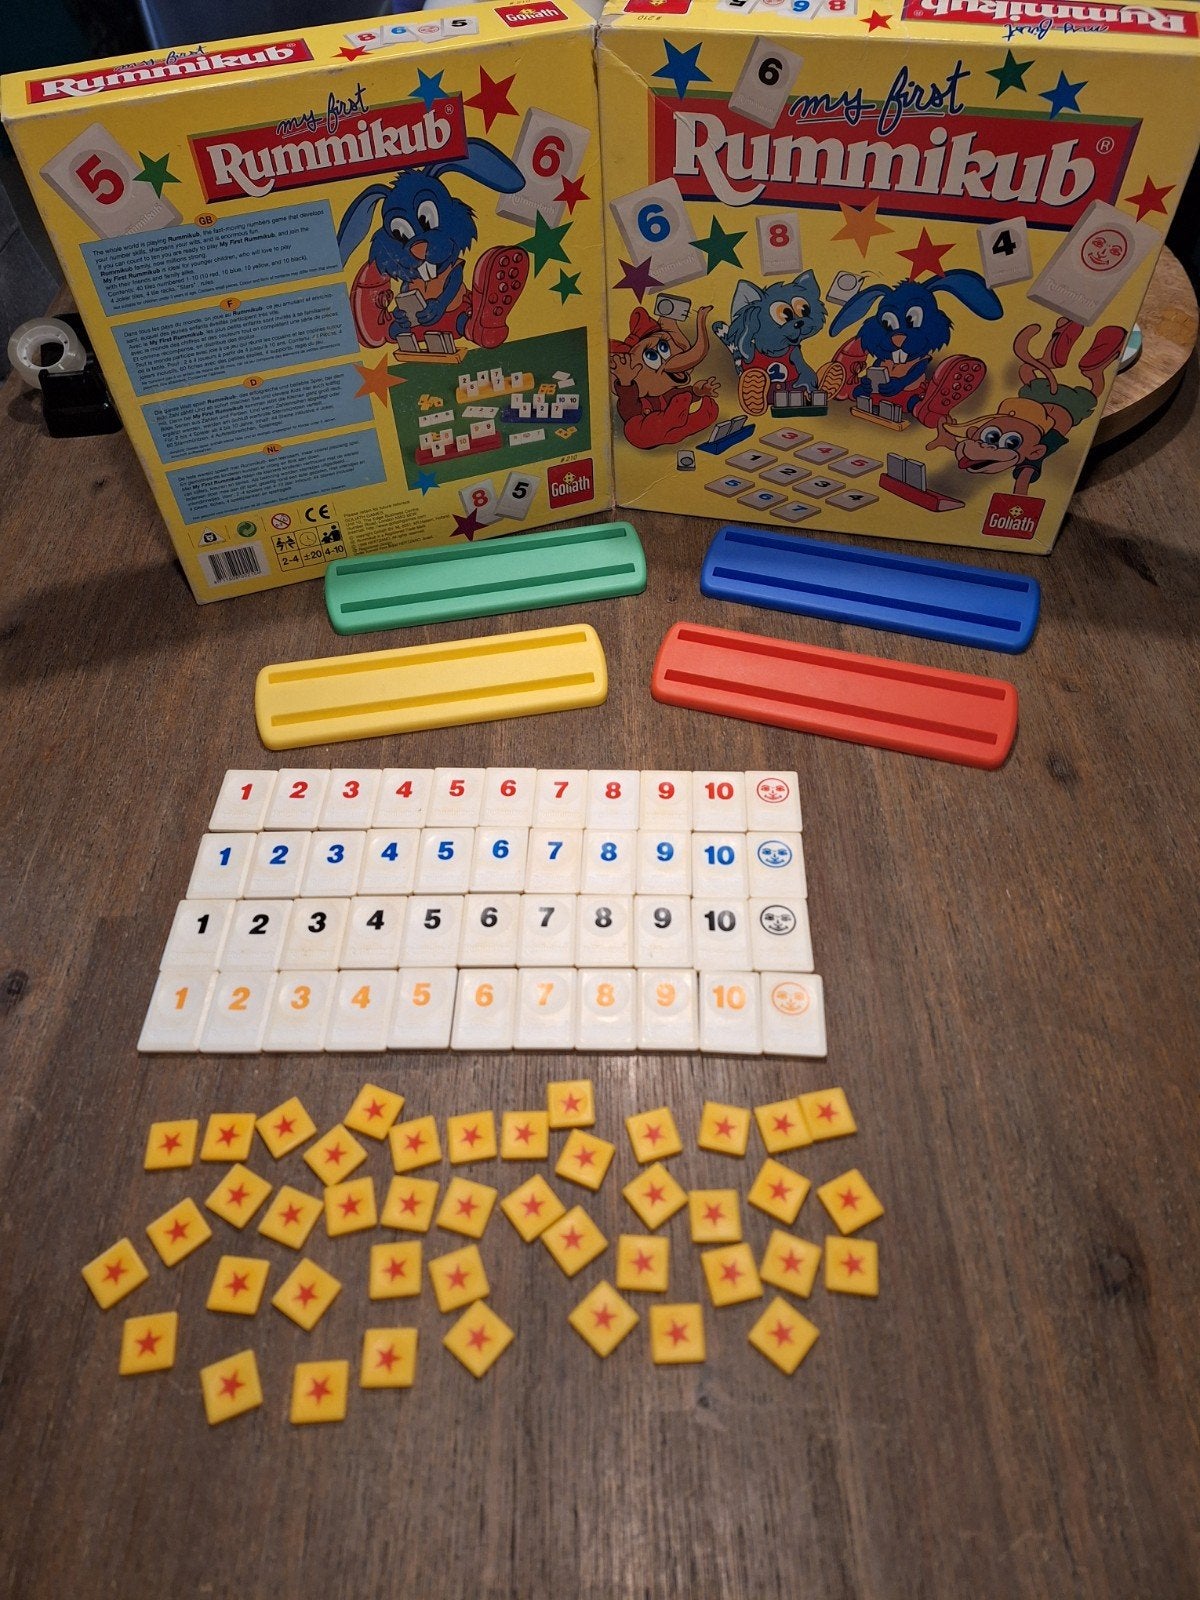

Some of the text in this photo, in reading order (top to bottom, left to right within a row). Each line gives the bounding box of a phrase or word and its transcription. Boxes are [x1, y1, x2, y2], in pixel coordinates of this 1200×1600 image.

[505, 9, 559, 21] Goliath
[829, 0, 847, 11] 8
[921, 0, 1187, 33] Rummikub
[451, 19, 469, 28] 5
[358, 32, 377, 42] 8
[41, 45, 293, 98] Rummikub
[758, 57, 783, 86] 6
[277, 83, 369, 135] my first
[788, 59, 971, 136] my first
[206, 110, 451, 197] Rummikub
[532, 135, 565, 177] 6
[672, 110, 1096, 207] Rummikub
[75, 153, 125, 205] 5
[198, 215, 213, 225] GB
[637, 203, 671, 242] 6
[769, 224, 790, 247] 8
[991, 230, 1017, 257] 4
[226, 300, 233, 308] F
[267, 446, 278, 454] NL
[779, 468, 798, 476] 2
[471, 489, 489, 507] 8
[511, 481, 529, 499] 5
[551, 475, 590, 498] Goliath
[989, 513, 1035, 532] Goliath
[282, 555, 299, 566] 2-4
[325, 545, 344, 556] 4-10
[241, 780, 734, 800] 1 2 3 4 5 6 7 8 9 10
[220, 839, 734, 866] 1 2 3 4 5 6 7 8 9 10
[197, 907, 736, 934] 1 2 3 4 5 6 7 8 9 10
[175, 983, 746, 1011] 1 2 3 4 5 6 7 8 9 10
